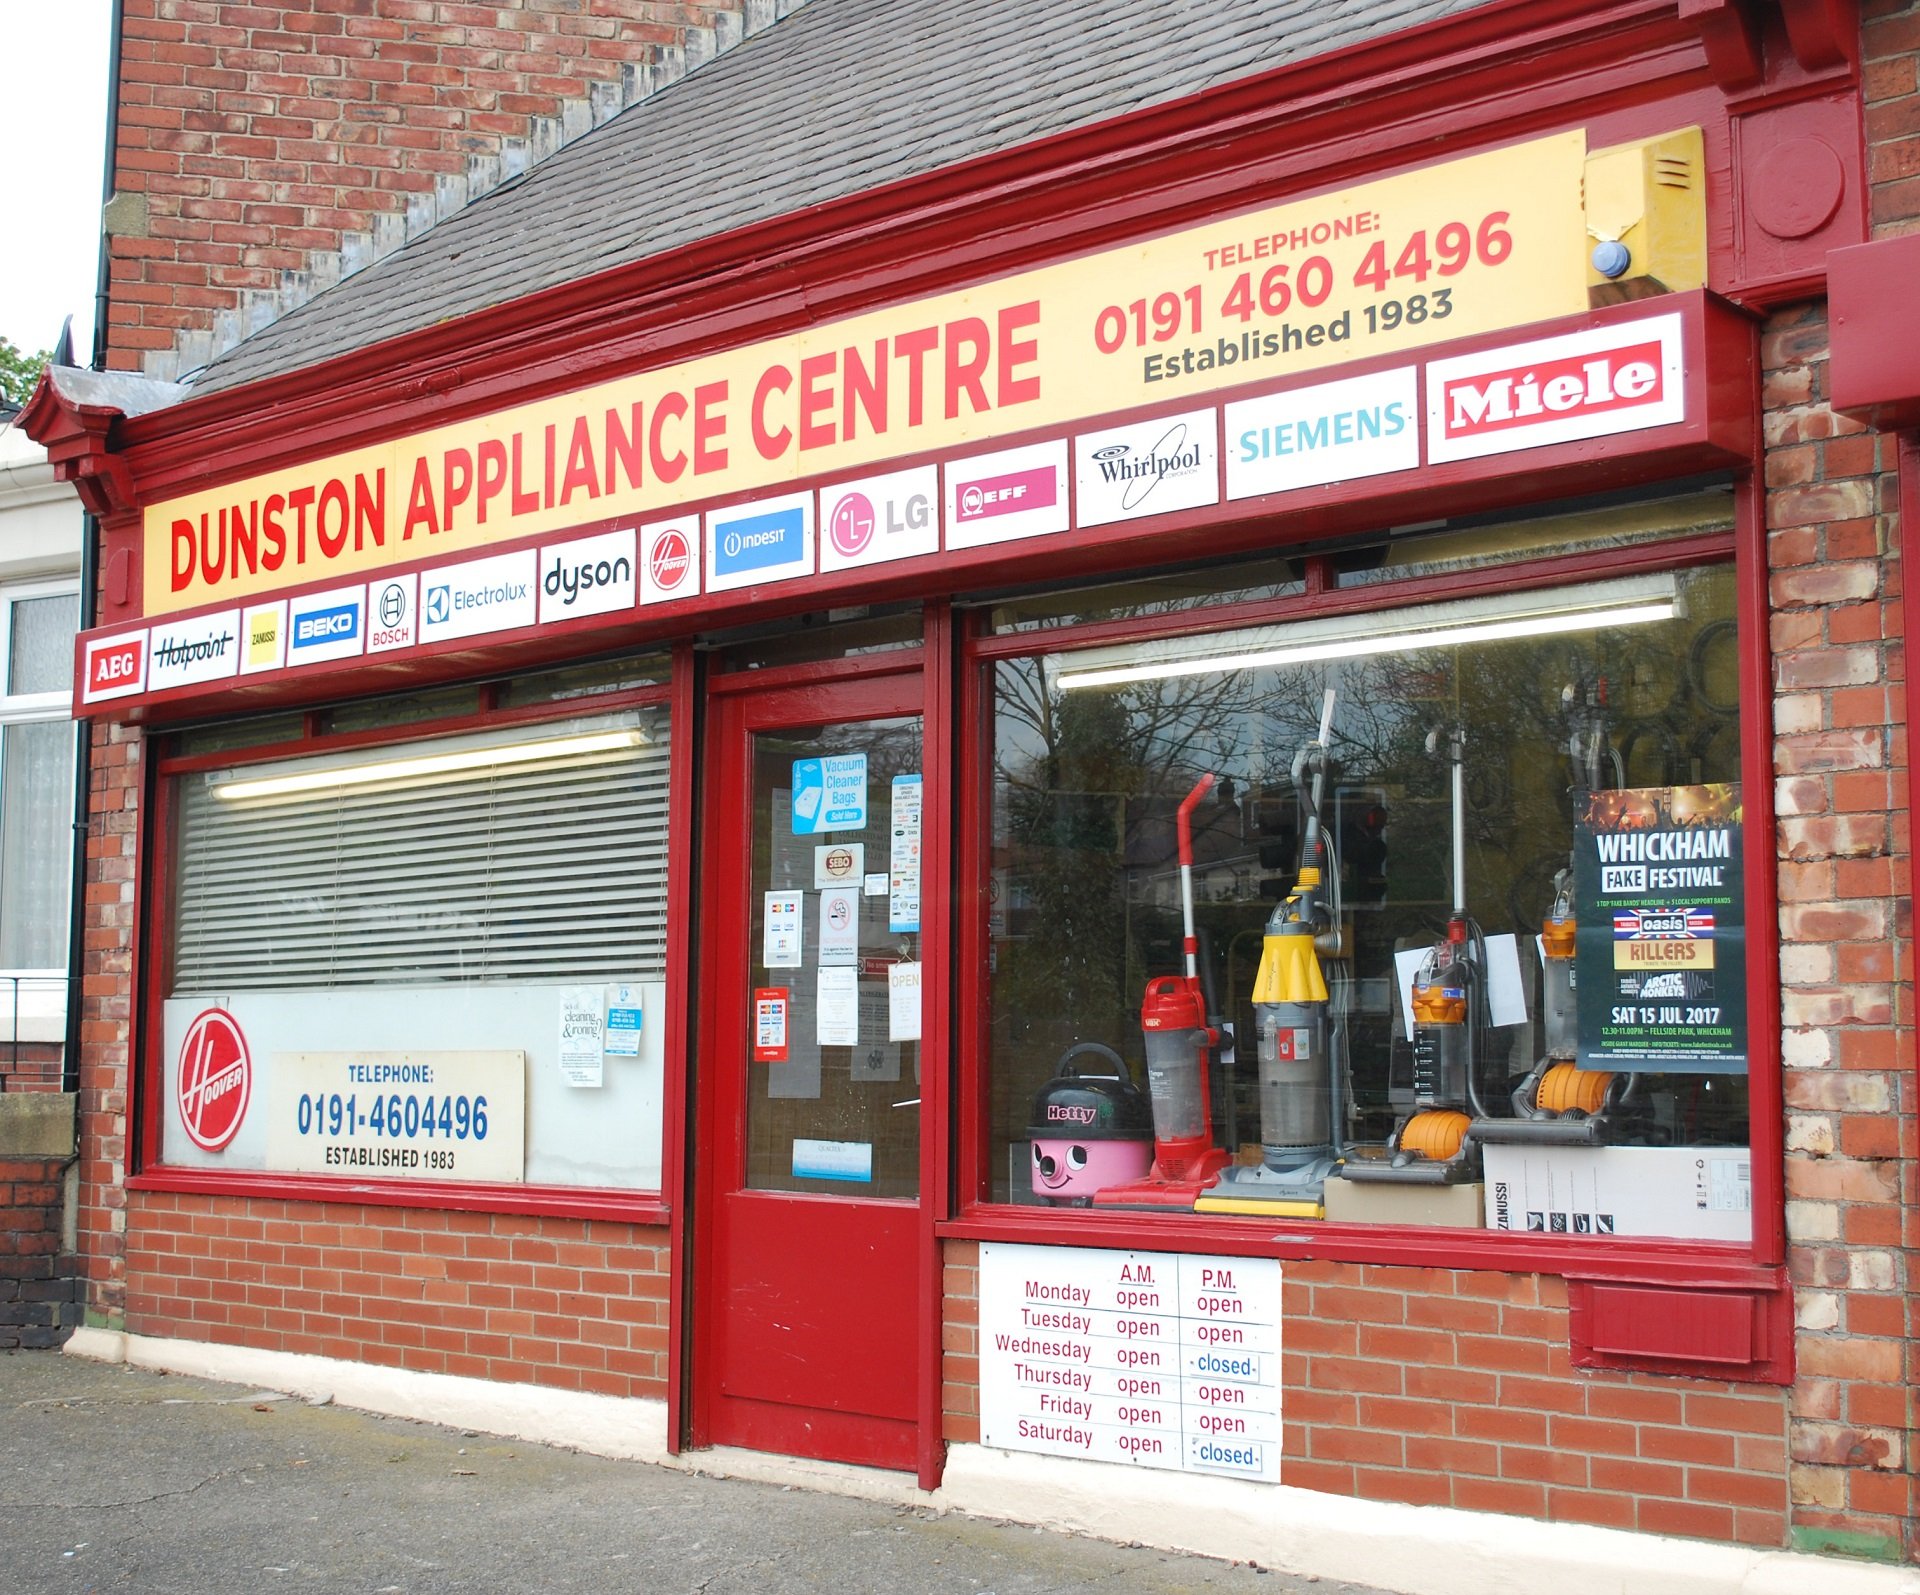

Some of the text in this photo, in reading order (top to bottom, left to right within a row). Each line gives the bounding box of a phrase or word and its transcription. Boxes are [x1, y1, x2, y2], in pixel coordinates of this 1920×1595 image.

[1203, 212, 1381, 271] TELEPHONE:
[1094, 211, 1513, 354] 0191 460 4496
[1143, 288, 1454, 383] Established 1983
[1450, 358, 1657, 429] Miele
[171, 300, 1041, 592] DUNSTON APPLIANCE CENTRE
[1240, 402, 1405, 463] SIEMENS
[1098, 443, 1201, 484] Whirlpool
[887, 494, 929, 534] LG
[962, 485, 1028, 517] NEFF
[544, 555, 630, 604] dyson
[454, 582, 527, 610] Electrolux
[252, 630, 275, 645] ZANUSSI
[298, 613, 352, 639] BEKO
[373, 627, 409, 646] BOSCH
[154, 630, 234, 670] Hotpoint
[96, 652, 134, 681] AEG
[825, 759, 863, 772] Vacuum
[827, 775, 863, 788] Cleaner
[832, 792, 856, 806] Bags
[1596, 830, 1730, 862] WHICKHAM
[828, 856, 849, 868] SEBO
[1607, 869, 1642, 888] FAKE
[1643, 917, 1683, 930] oasis
[1631, 942, 1696, 960] KILLERS
[892, 974, 920, 987] OPEN
[1640, 986, 1685, 998] MONKEYS
[1645, 973, 1682, 988] ARCTIC
[564, 1010, 596, 1024] cleaning
[1612, 1007, 1720, 1024] SAT 15 JUL 2017
[1650, 1027, 1676, 1035] FELLSIDE
[1696, 1028, 1732, 1036] WHICKHAM
[349, 1064, 434, 1084] TELEPHONE:
[298, 1093, 488, 1140] 0191-4604496
[1048, 1105, 1096, 1124] Hetty
[325, 1147, 455, 1170] ESTABLISHED 1983
[1495, 1182, 1509, 1231] ZANUSSI
[1120, 1264, 1237, 1289] A.M. P.M.
[1025, 1281, 1242, 1316] Monday open open
[1021, 1308, 1243, 1346] Tuesday open open
[996, 1334, 1251, 1375] Wednesday open closed
[1014, 1364, 1244, 1406] Thursday open open
[1040, 1394, 1245, 1436] Friday open open
[1018, 1420, 1253, 1465] Saturday open closed
